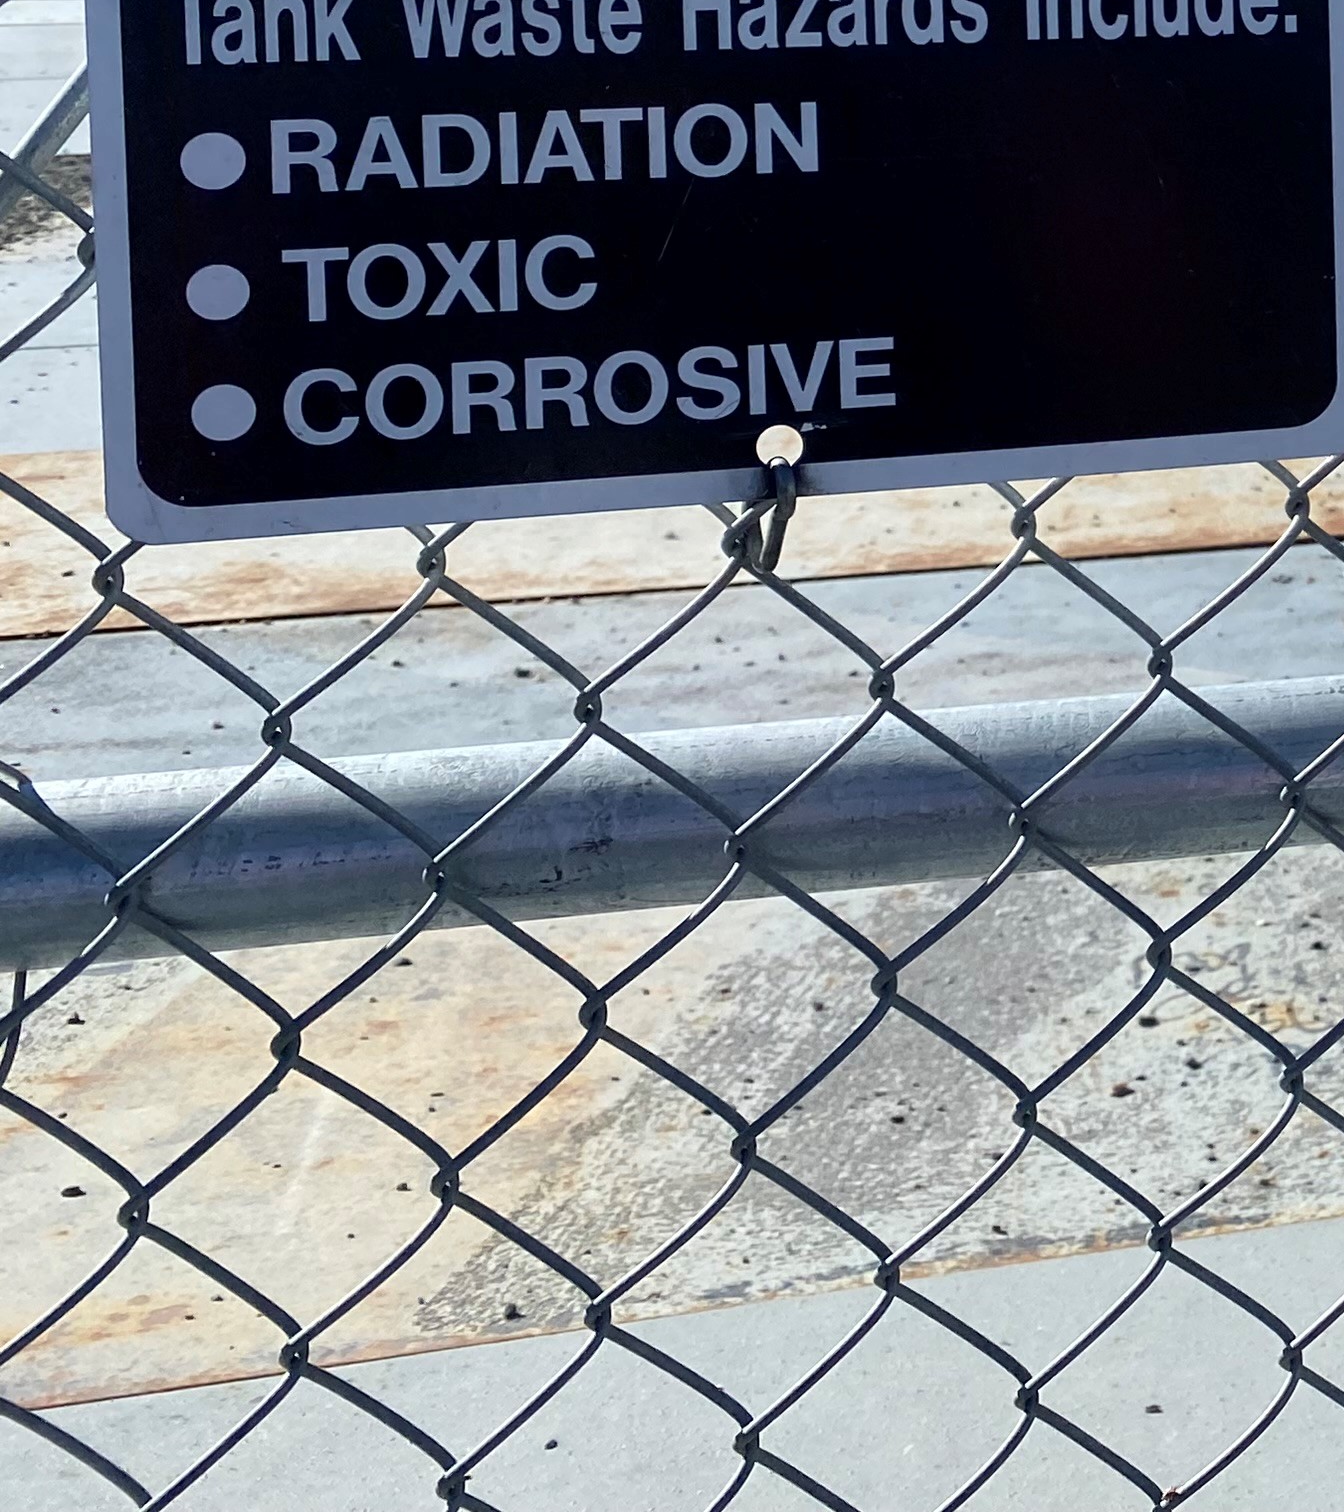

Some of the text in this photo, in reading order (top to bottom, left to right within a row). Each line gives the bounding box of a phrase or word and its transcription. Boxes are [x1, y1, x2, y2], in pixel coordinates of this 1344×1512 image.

[271, 102, 818, 194] RADIATION
[282, 235, 597, 322] TOXIC
[284, 337, 896, 445] CORROSIVE
